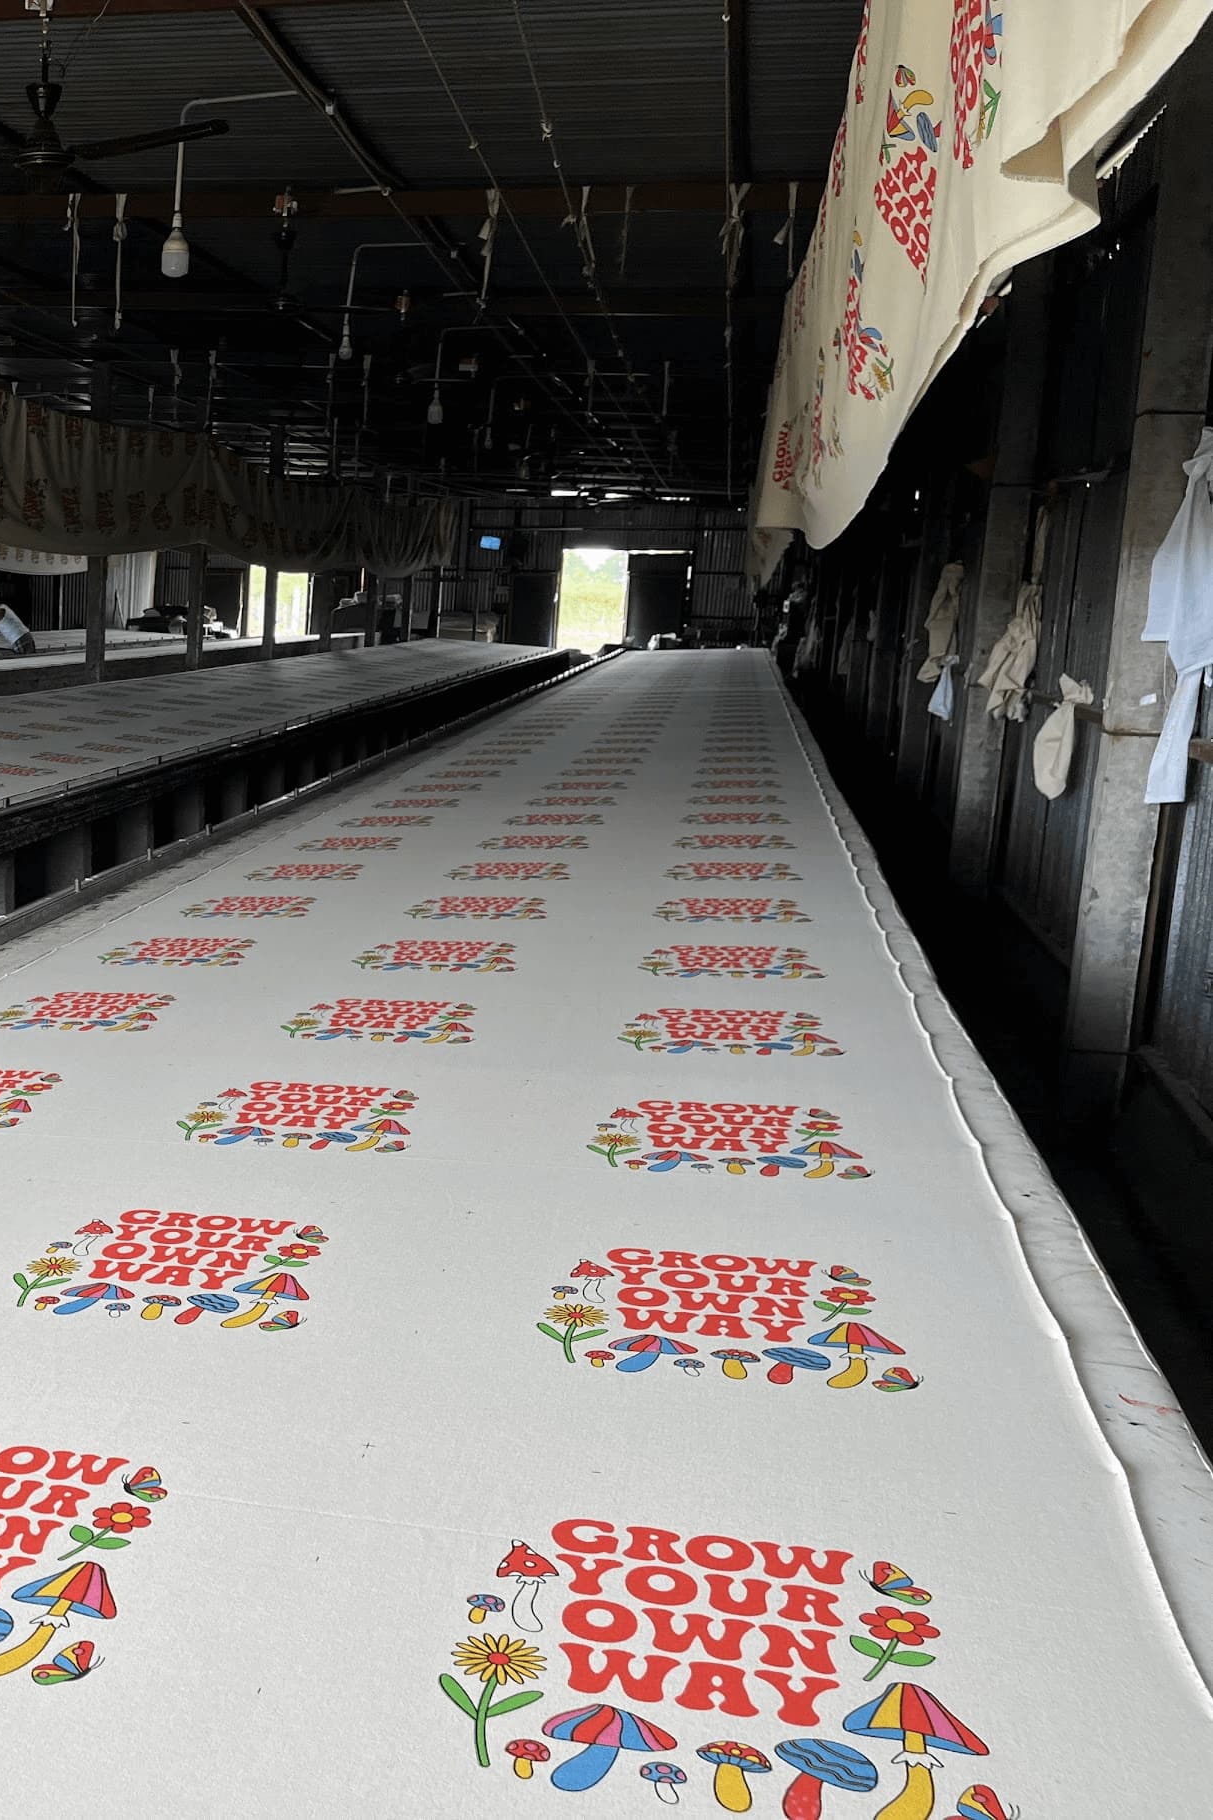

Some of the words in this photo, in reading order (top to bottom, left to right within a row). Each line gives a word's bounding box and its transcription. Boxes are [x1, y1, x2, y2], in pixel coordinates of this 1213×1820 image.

[50, 997, 144, 1005] YOUR
[54, 991, 160, 999] GROW
[336, 998, 453, 1008] GROW
[32, 1010, 124, 1019] WAY
[41, 1003, 134, 1012] OWN
[335, 1005, 441, 1015] YOUR
[657, 1008, 788, 1018] GROW
[329, 1019, 429, 1030] WAY
[332, 1012, 435, 1022] OWN
[660, 1015, 783, 1025] YOUR
[665, 1022, 779, 1033] OWN
[665, 1030, 780, 1041] WAY
[250, 1081, 391, 1097] GROW
[249, 1090, 375, 1107] YOUR
[242, 1101, 366, 1118] OWN
[638, 1100, 799, 1116] GROW
[235, 1112, 358, 1130] WAY
[641, 1110, 793, 1127] YOUR
[647, 1123, 788, 1140] OWN
[647, 1135, 789, 1153] WAY
[120, 1209, 296, 1235] GROW
[116, 1224, 273, 1252] YOUR
[101, 1242, 258, 1270] OWN
[607, 1248, 817, 1277] GROW
[88, 1259, 245, 1290] WAY
[611, 1265, 809, 1297] YOUR
[617, 1287, 804, 1319] OWN
[617, 1307, 806, 1342] WAY
[552, 1519, 852, 1584] GROW
[556, 1554, 843, 1626] YOUR
[562, 1600, 836, 1674] OWN
[560, 1643, 839, 1726] WAY
